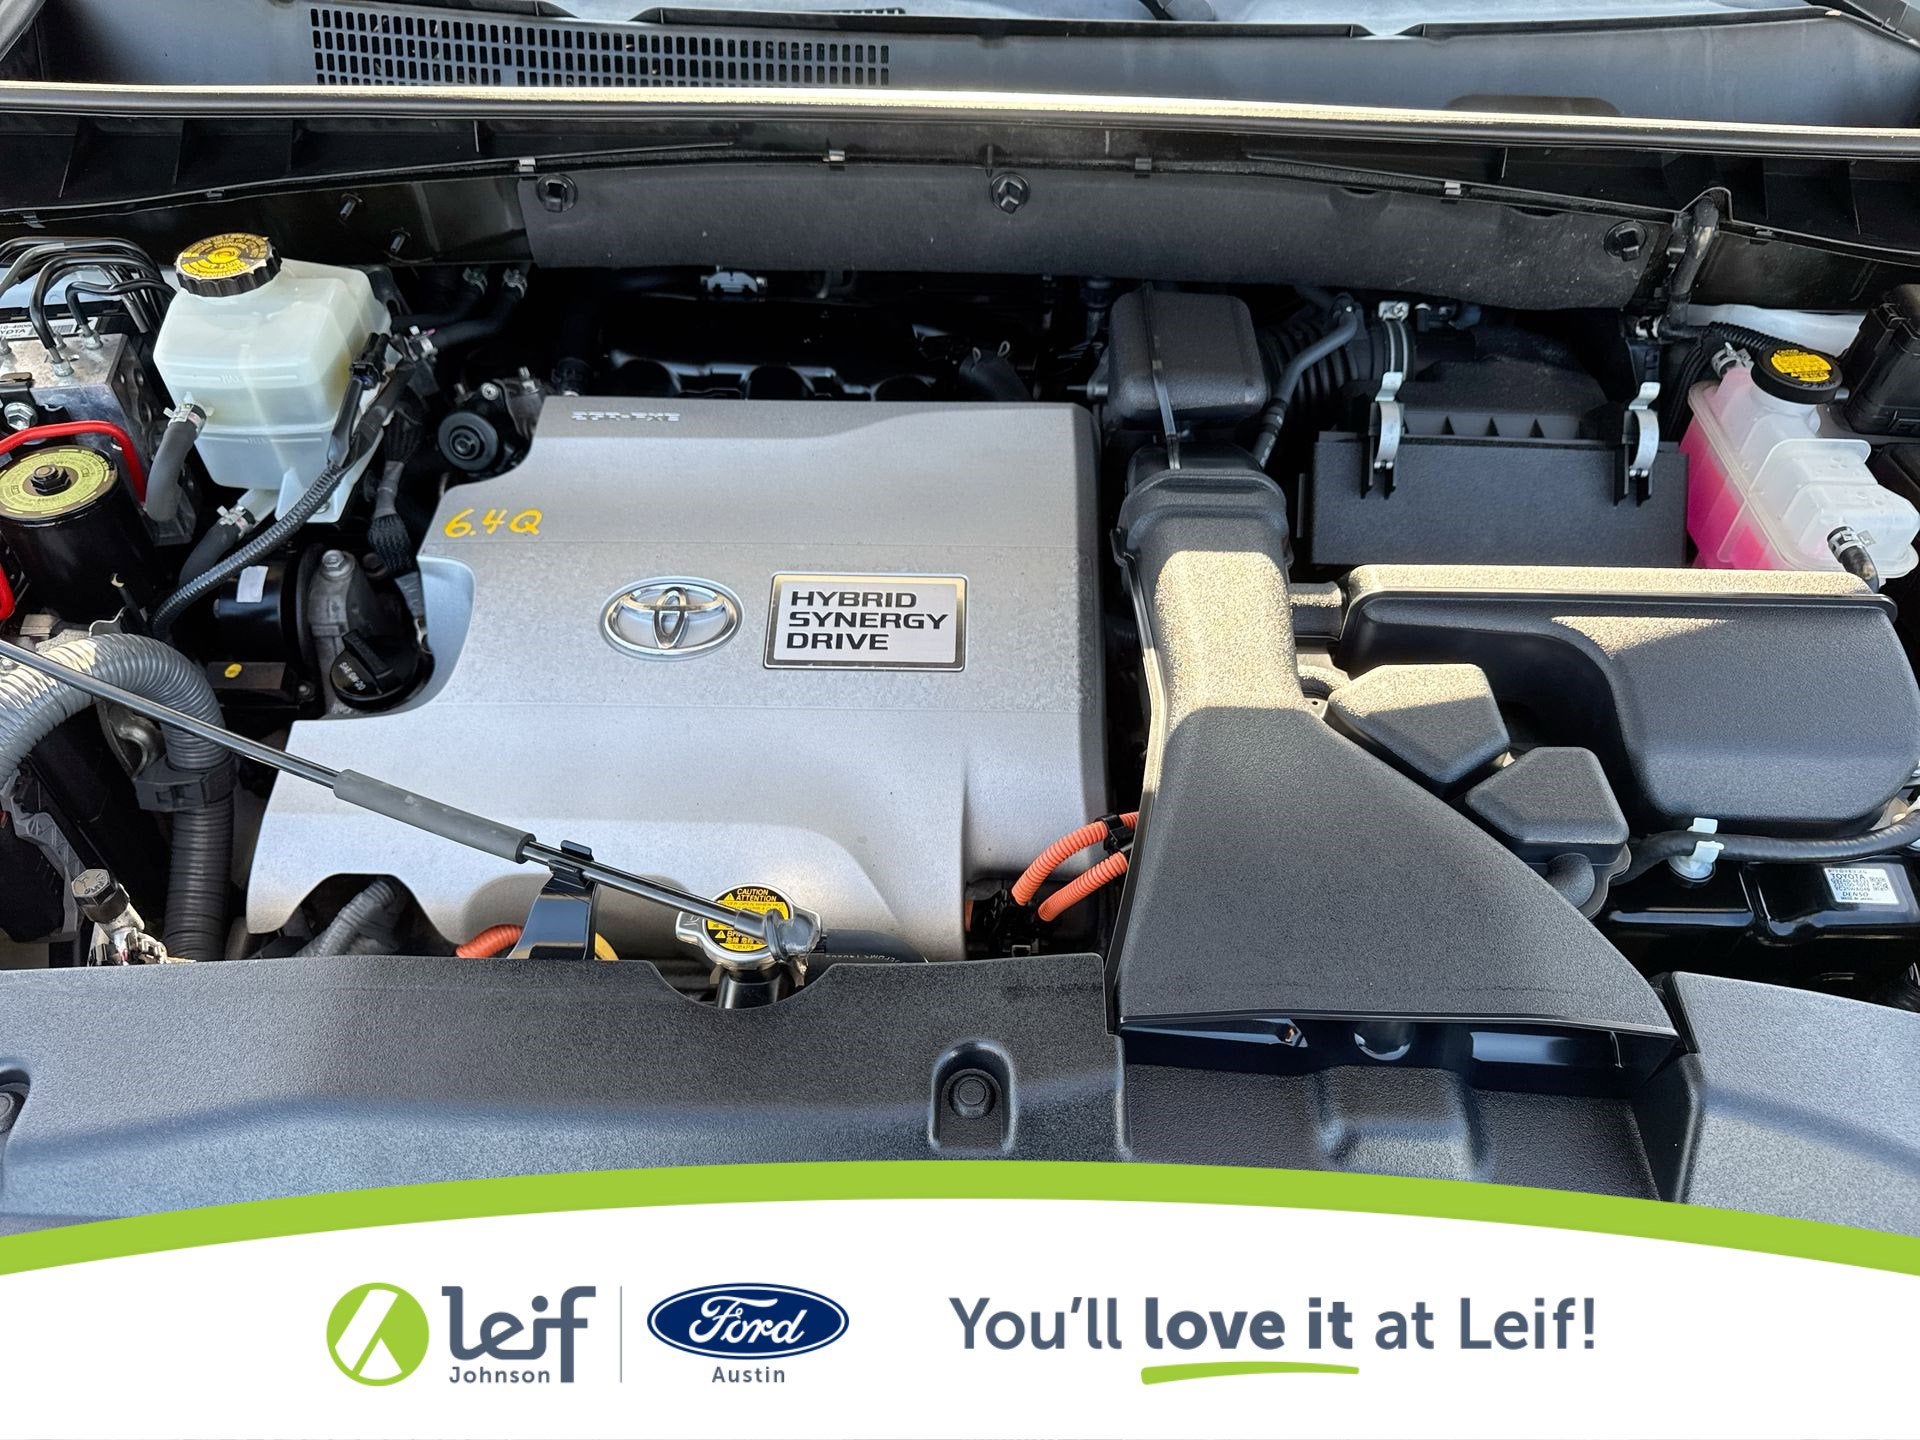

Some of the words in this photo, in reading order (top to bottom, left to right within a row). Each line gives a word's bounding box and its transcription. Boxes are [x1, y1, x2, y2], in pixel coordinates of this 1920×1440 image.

[443, 507, 543, 538] 6.4Q
[791, 591, 917, 608] HYBRID
[788, 611, 949, 630] SYNERGY
[787, 633, 889, 651] DRIVE
[736, 888, 769, 896] CAUTION
